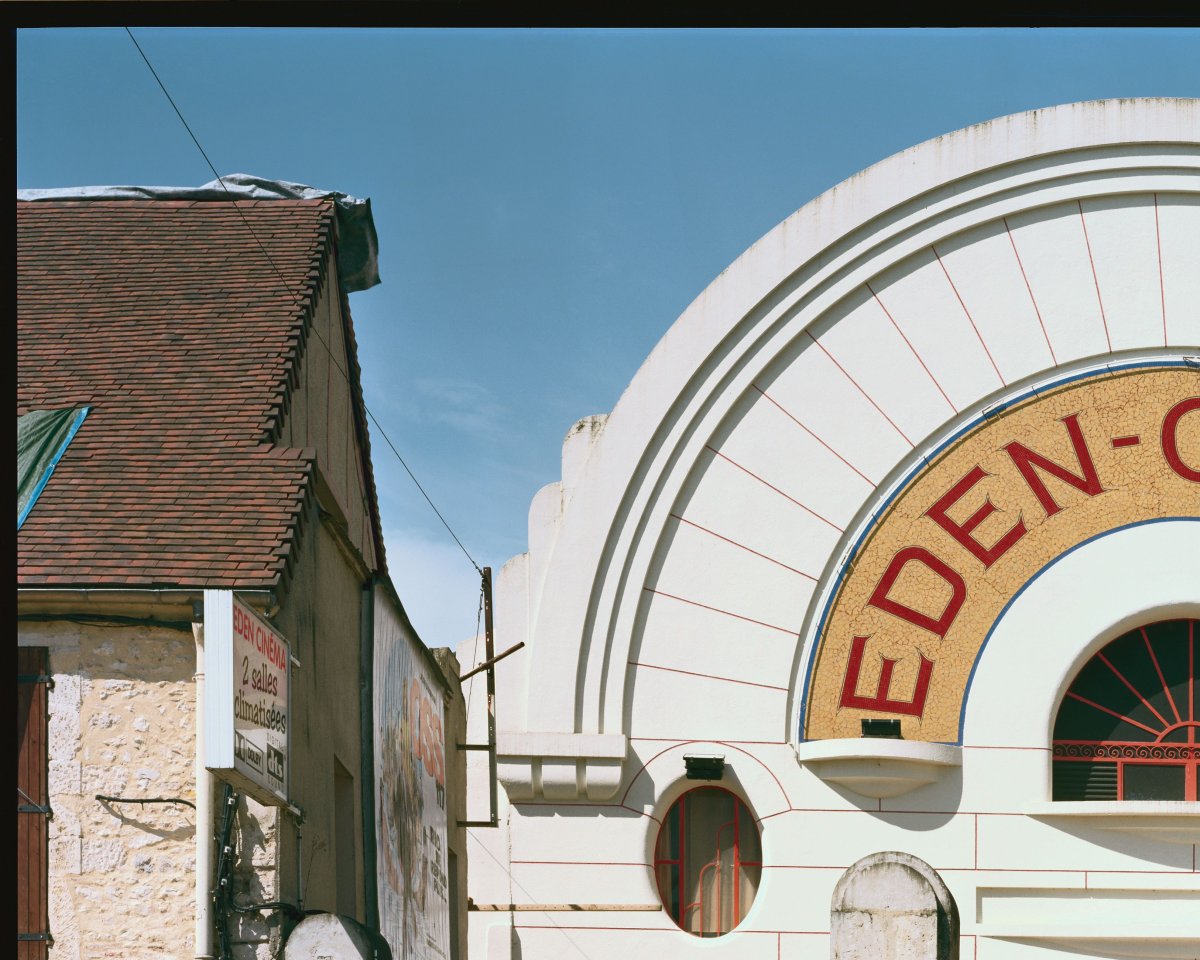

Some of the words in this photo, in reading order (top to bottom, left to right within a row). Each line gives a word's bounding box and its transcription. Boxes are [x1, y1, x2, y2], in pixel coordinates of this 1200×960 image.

[232, 604, 255, 646] EDEN
[255, 625, 287, 674] CINÉMA
[242, 655, 249, 685] 2
[251, 662, 278, 697] salles
[234, 689, 287, 735] climatisées
[267, 747, 283, 778] dts
